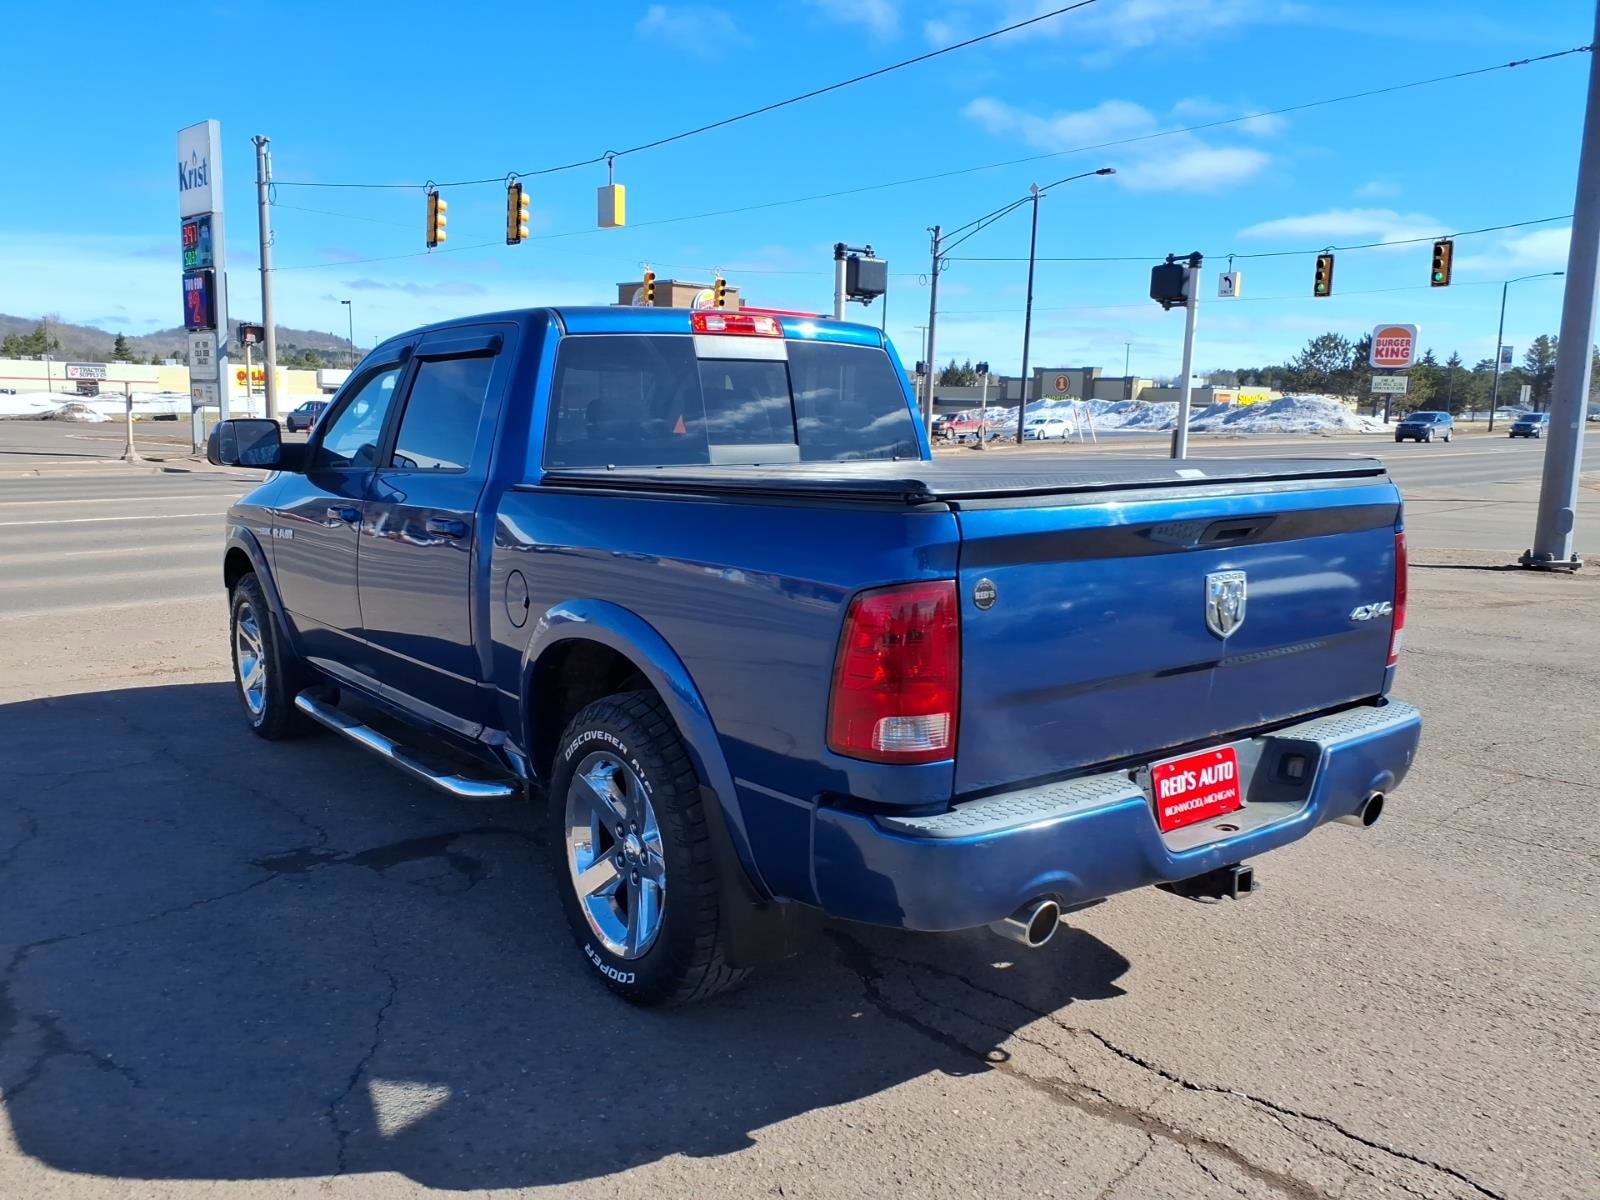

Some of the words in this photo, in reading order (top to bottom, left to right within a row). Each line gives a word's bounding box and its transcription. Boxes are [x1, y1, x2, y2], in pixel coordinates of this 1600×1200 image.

[178, 155, 208, 192] Krist
[1375, 347, 1410, 358] KING
[1376, 338, 1411, 347] BURGER
[1211, 572, 1243, 583] DODGE
[565, 730, 628, 761] DISCOVERER
[1160, 770, 1197, 799] RED'S
[1199, 760, 1234, 788] AUTO
[1203, 788, 1236, 805] MICHIGAN
[584, 943, 635, 984] COOPER
